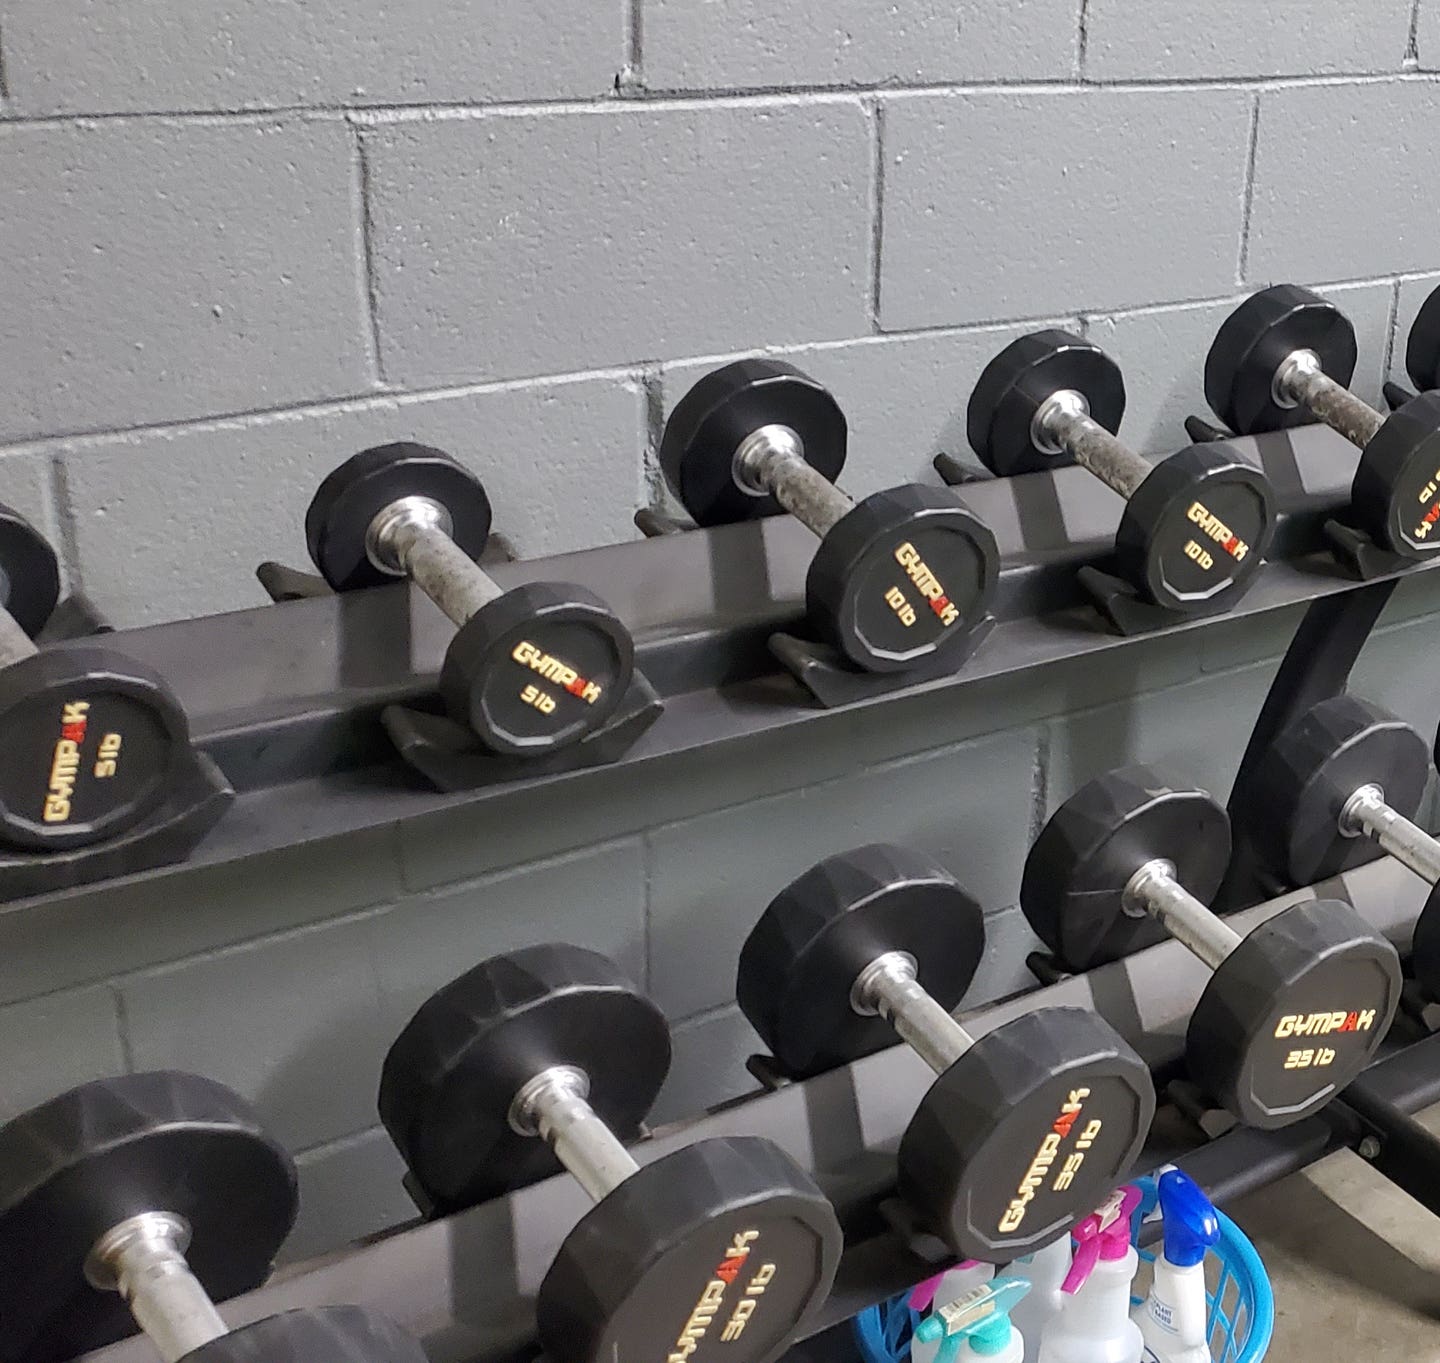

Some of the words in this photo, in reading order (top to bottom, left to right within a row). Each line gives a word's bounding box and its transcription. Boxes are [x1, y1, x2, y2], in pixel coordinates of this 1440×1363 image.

[1419, 481, 1437, 504] lb
[1186, 501, 1249, 562] GYMPAK
[895, 542, 960, 626] GYMPAK
[512, 641, 602, 705] GYMPAK
[43, 701, 91, 822] GYMPAK
[1274, 1009, 1376, 1038] GYMPAK
[998, 1087, 1091, 1233] GYMPAK
[1053, 1152, 1085, 1192] 35
[1075, 1119, 1102, 1149] lb
[667, 1230, 760, 1363] YMPAK
[719, 1299, 757, 1342] 30
[745, 1263, 777, 1296] lb
